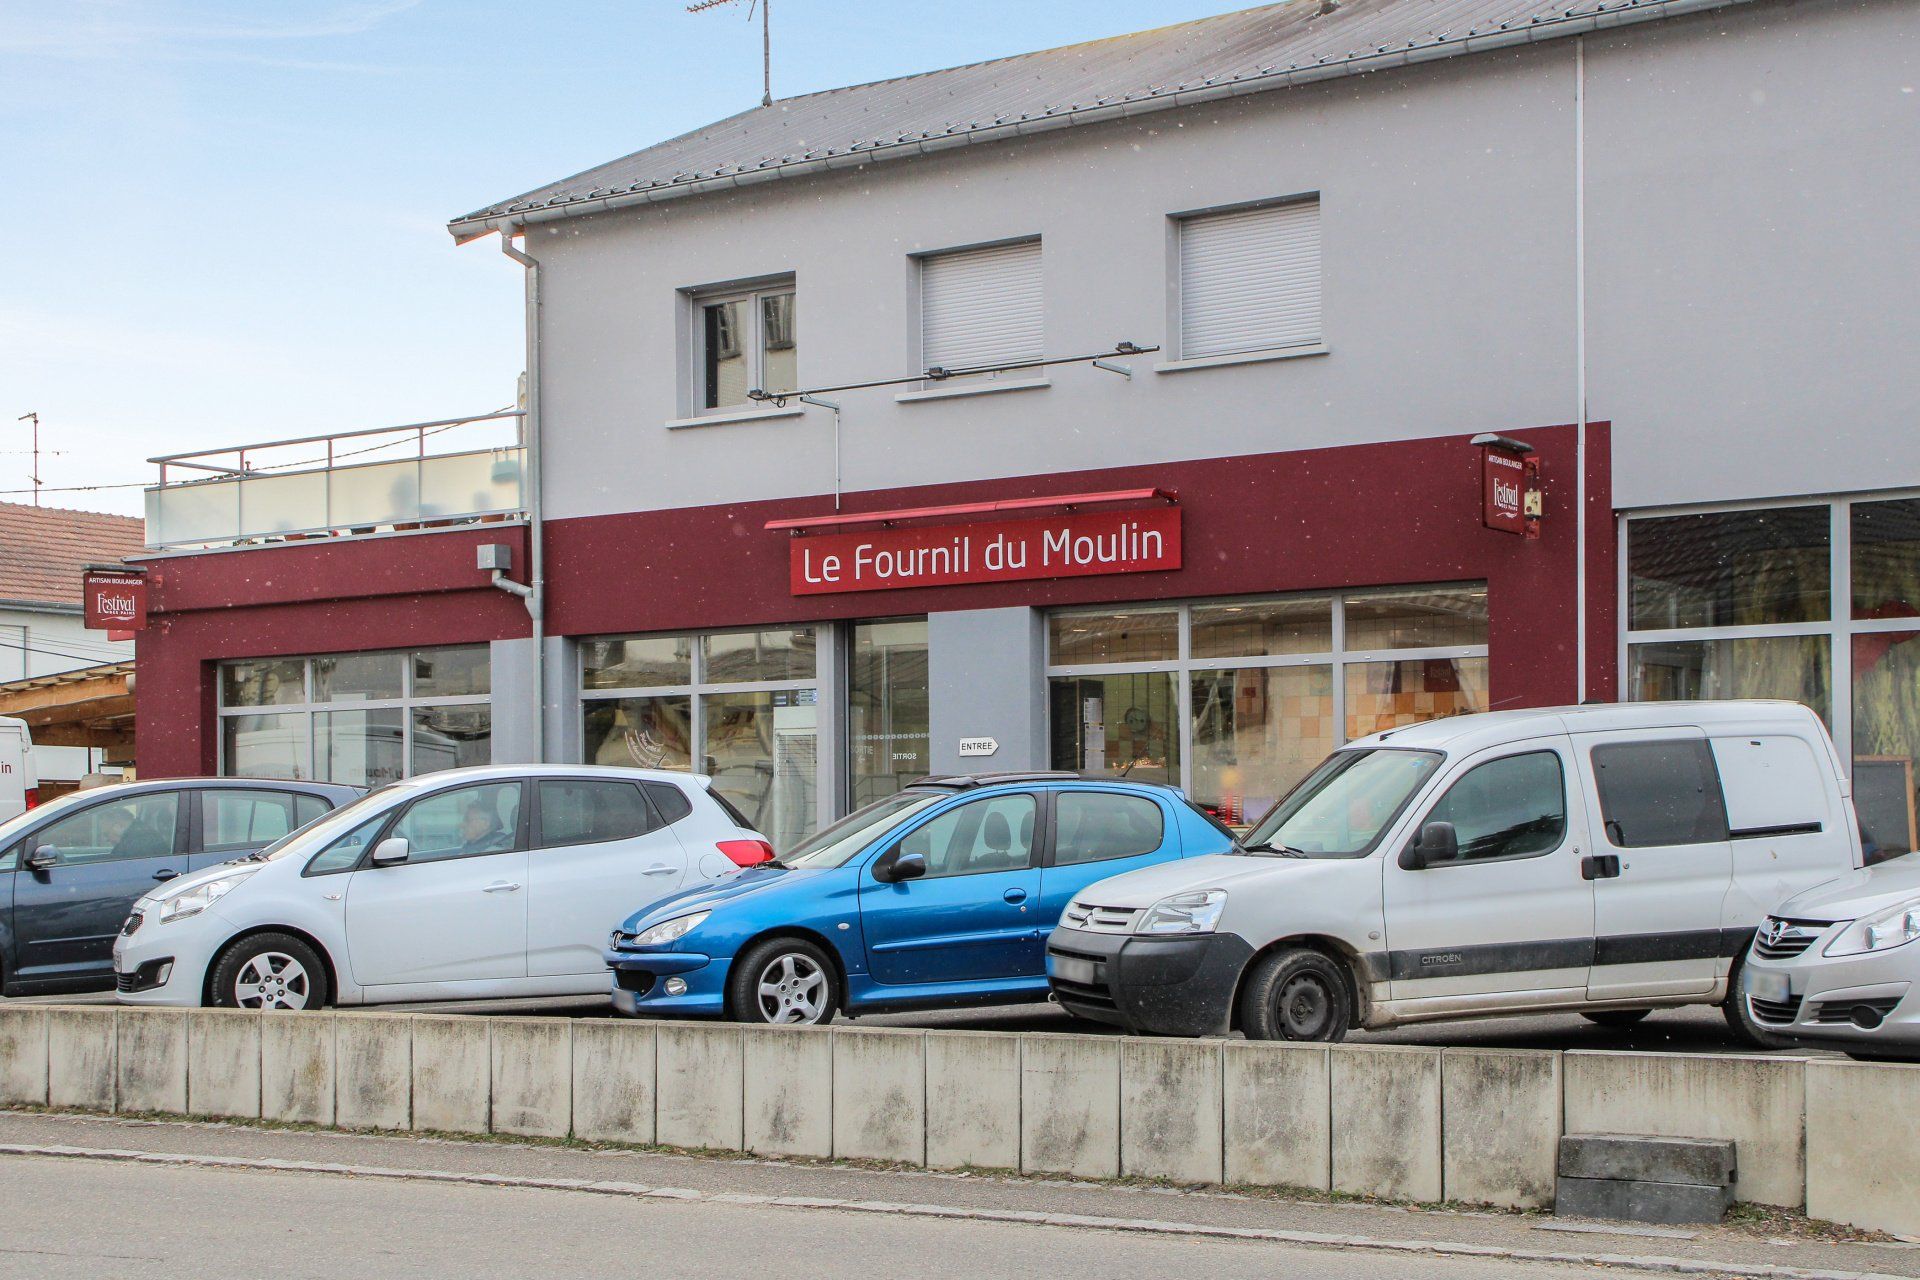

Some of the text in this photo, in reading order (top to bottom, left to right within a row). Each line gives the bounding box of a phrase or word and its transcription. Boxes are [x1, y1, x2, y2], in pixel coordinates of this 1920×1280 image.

[1494, 477, 1518, 507] Festival
[803, 522, 1163, 584] Le Fournil du Moulin
[97, 593, 136, 614] Festival
[961, 742, 993, 751] ENTREE
[1421, 953, 1462, 964] CITROËN
